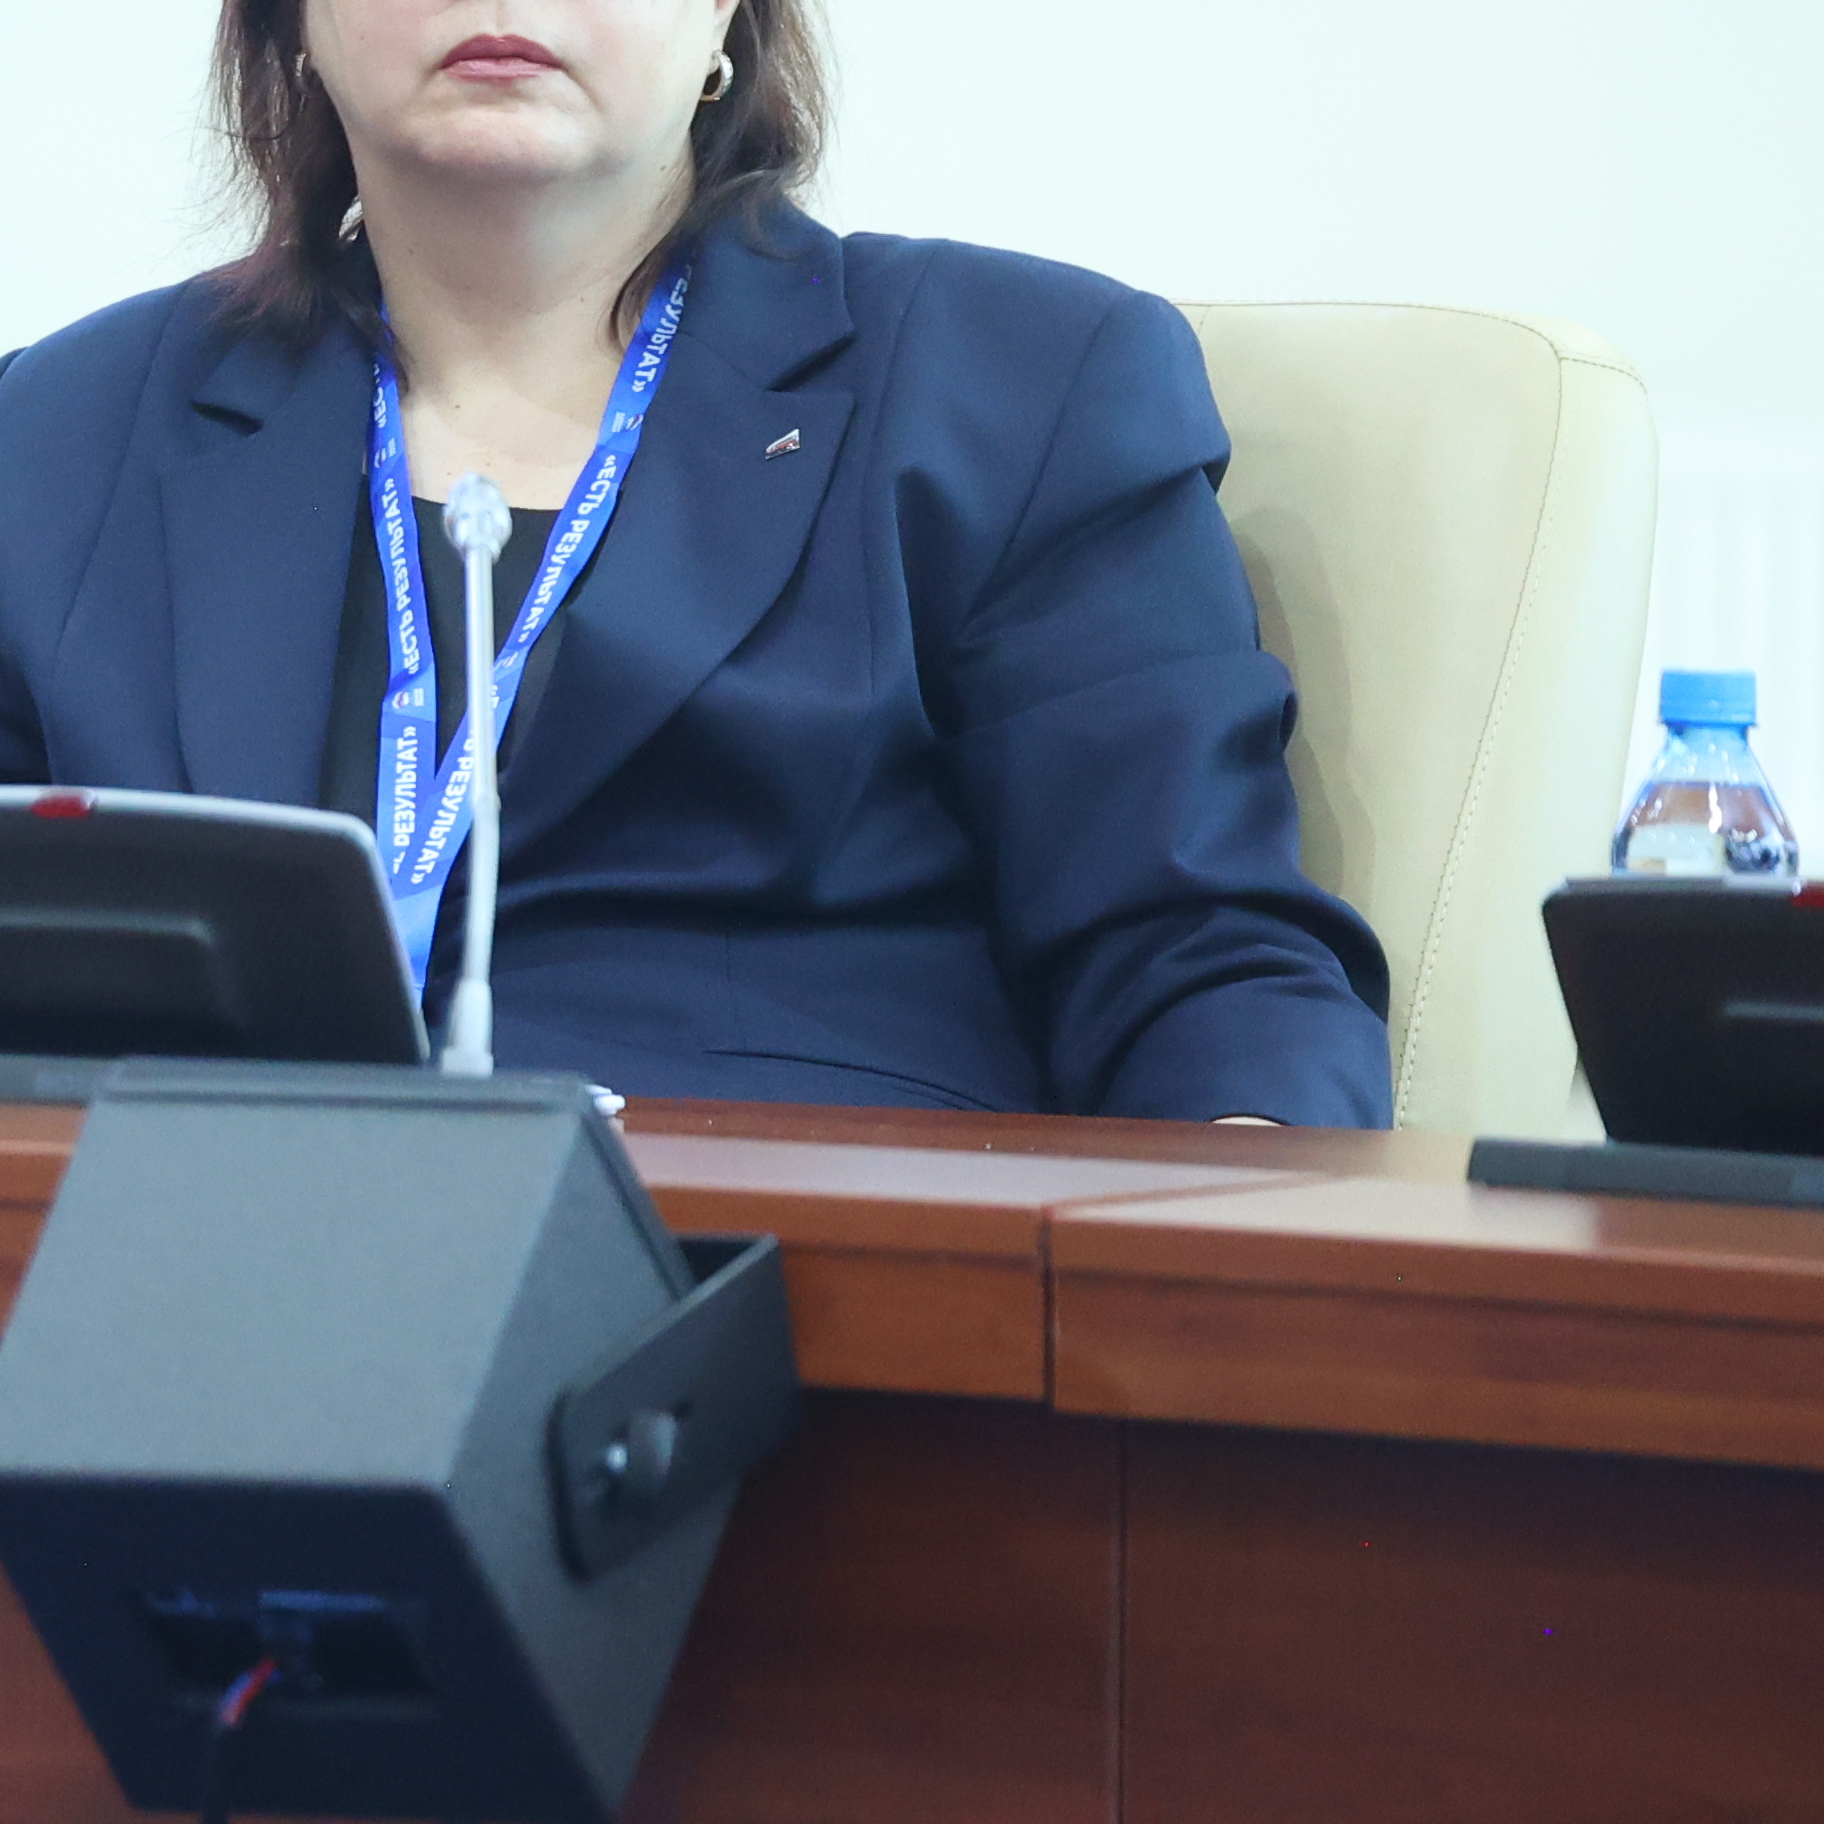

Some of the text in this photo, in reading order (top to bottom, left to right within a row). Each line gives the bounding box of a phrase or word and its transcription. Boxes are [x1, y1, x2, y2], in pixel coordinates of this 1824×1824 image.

[632, 272, 690, 392] ЕЗУЛЬТАТ»
[381, 478, 412, 611] РЕЗУЛЬТАТ»
[518, 455, 617, 642] «ЕСТЬ РЕЗУЛЬТАТ»
[399, 610, 421, 675] «ЕСТЬ
[393, 726, 418, 847] РЕЗУЛЬТАТ»
[410, 757, 474, 885] РЕЗУЛЬТАТ»
